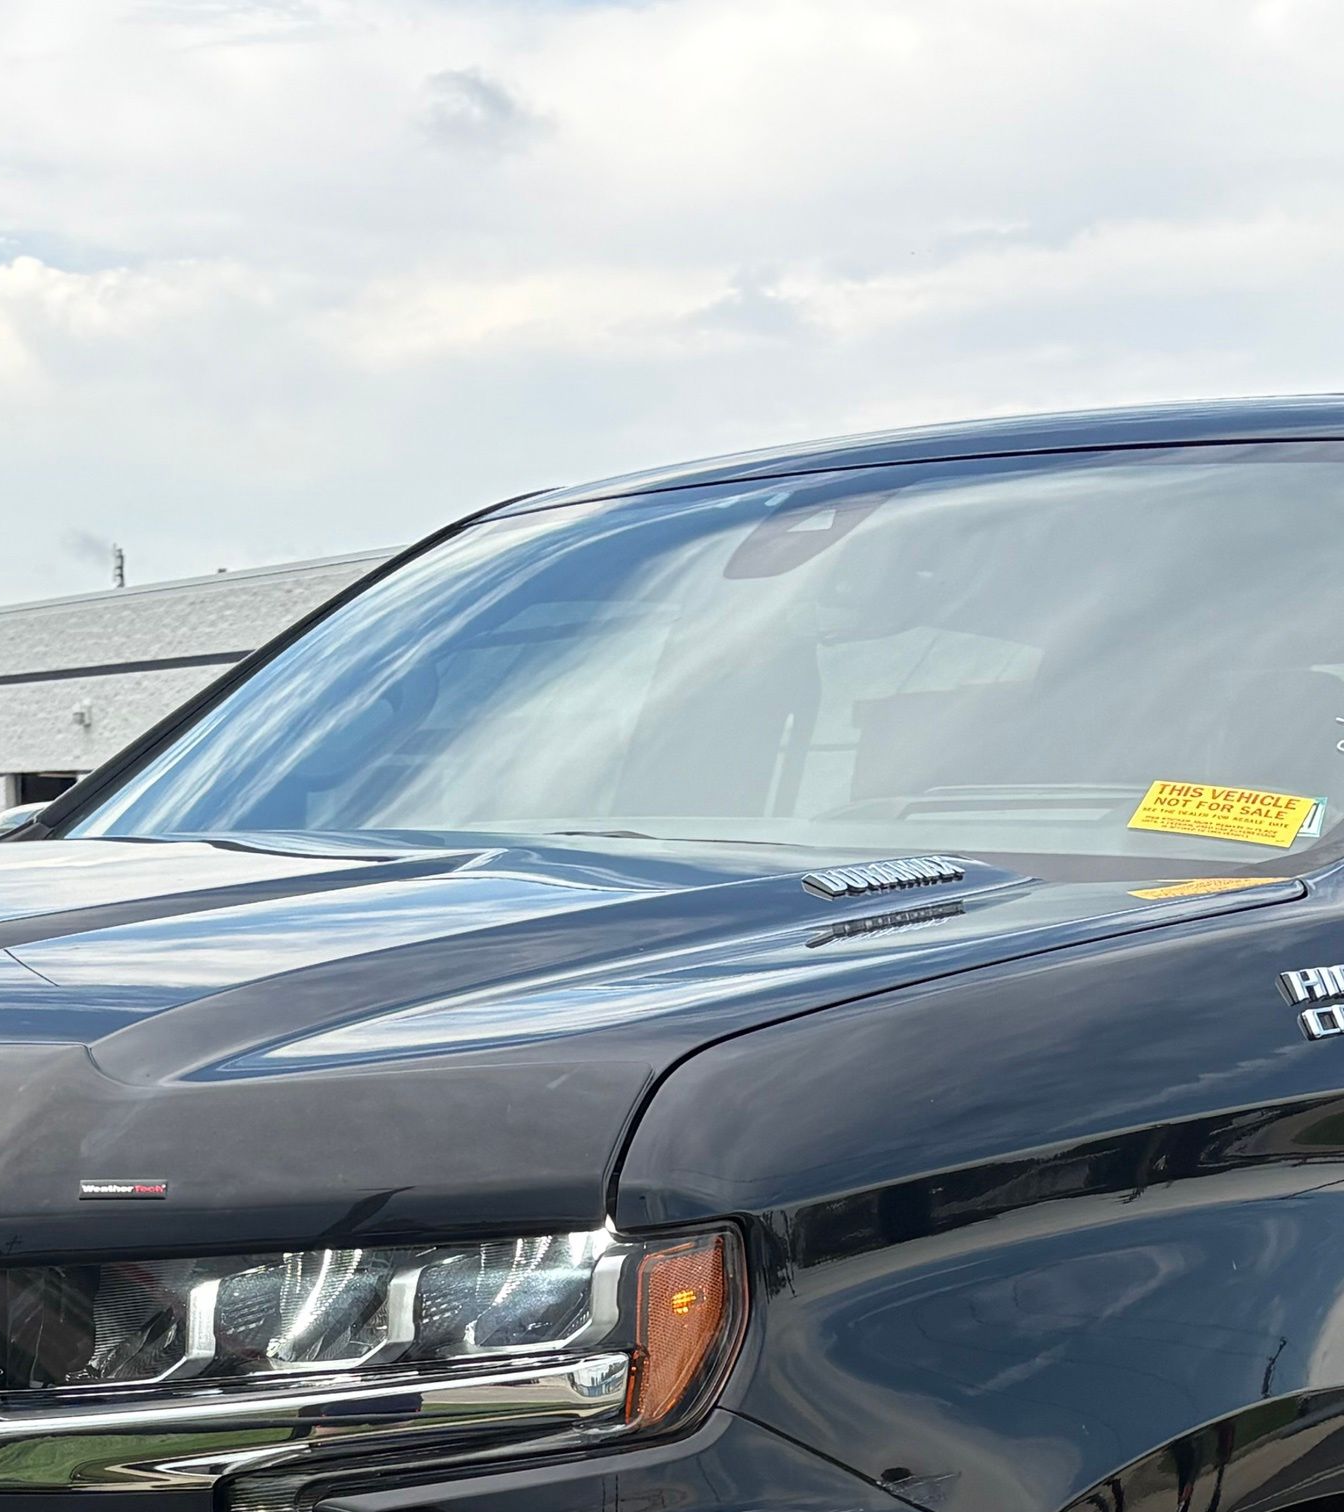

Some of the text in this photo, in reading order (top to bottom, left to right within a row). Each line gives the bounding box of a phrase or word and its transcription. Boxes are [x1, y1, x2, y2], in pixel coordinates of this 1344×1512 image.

[1153, 797, 1189, 809] NOT
[1196, 800, 1235, 813] FOR
[1240, 805, 1289, 821] SALE
[1157, 783, 1301, 811] THIS VEHICLE
[802, 855, 966, 894] DURAMAX
